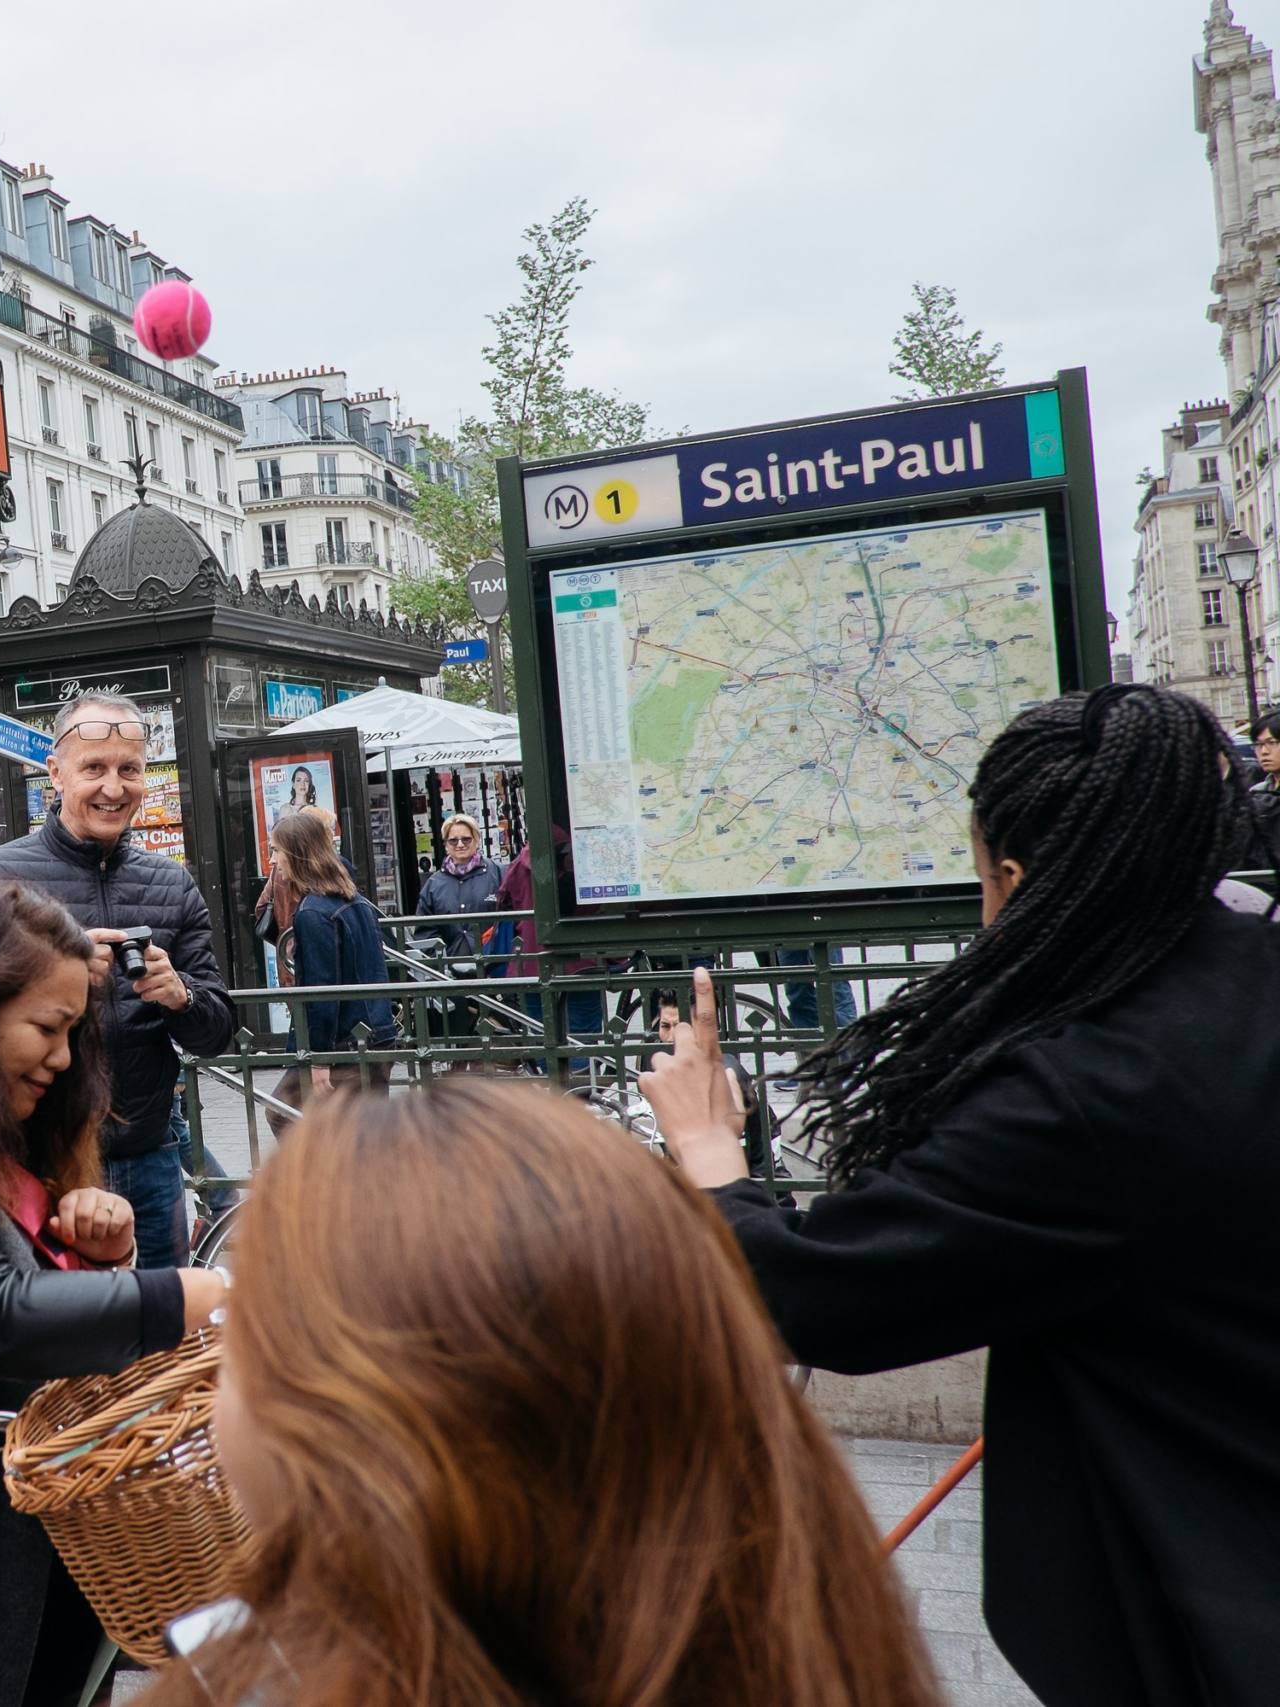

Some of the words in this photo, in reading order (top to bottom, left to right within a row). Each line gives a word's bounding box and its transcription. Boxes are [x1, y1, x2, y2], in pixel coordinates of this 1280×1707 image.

[607, 490, 622, 515] 1
[700, 421, 985, 508] Saint-Paul
[471, 577, 507, 595] TAXI
[446, 647, 470, 659] Paul
[58, 679, 125, 701] Presse
[280, 684, 318, 717] Parisien
[31, 737, 53, 752] d'Appe
[406, 747, 502, 765] Schweppes
